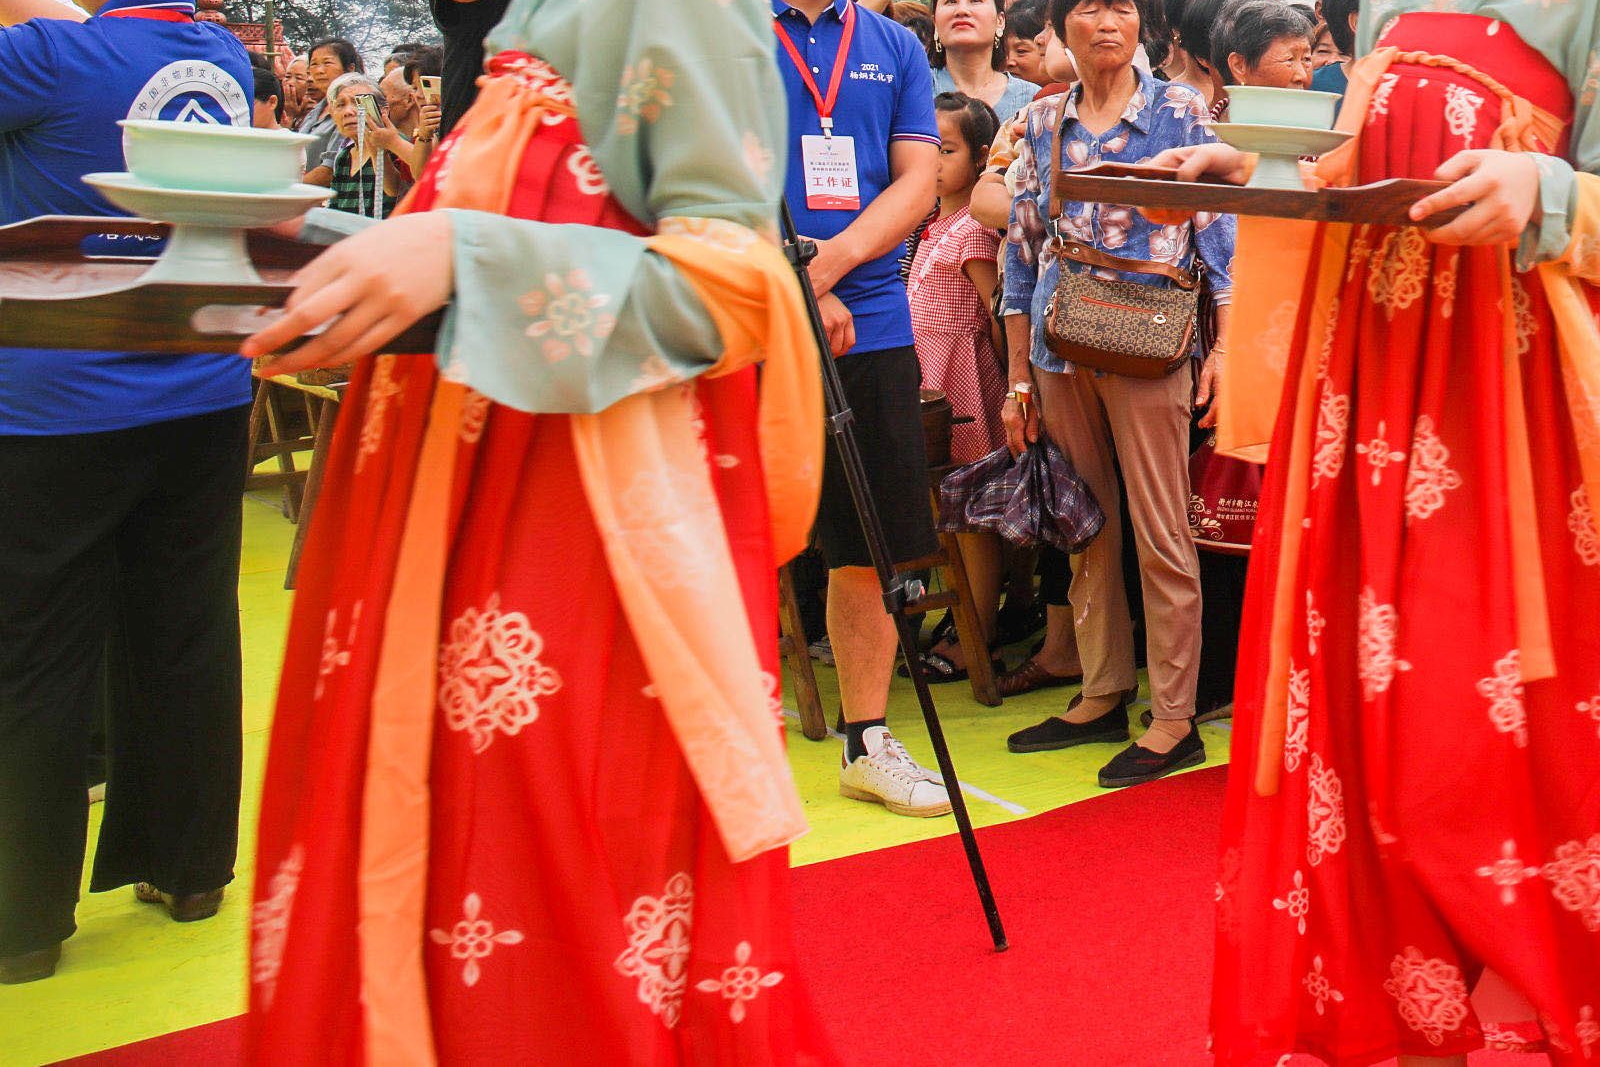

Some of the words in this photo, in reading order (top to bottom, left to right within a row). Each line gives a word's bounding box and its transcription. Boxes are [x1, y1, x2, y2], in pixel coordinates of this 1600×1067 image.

[860, 63, 879, 71] 2021
[849, 70, 894, 83] 杨炯文化节
[138, 66, 240, 112] 中国非物质文化遗产
[812, 176, 853, 188] 工作证
